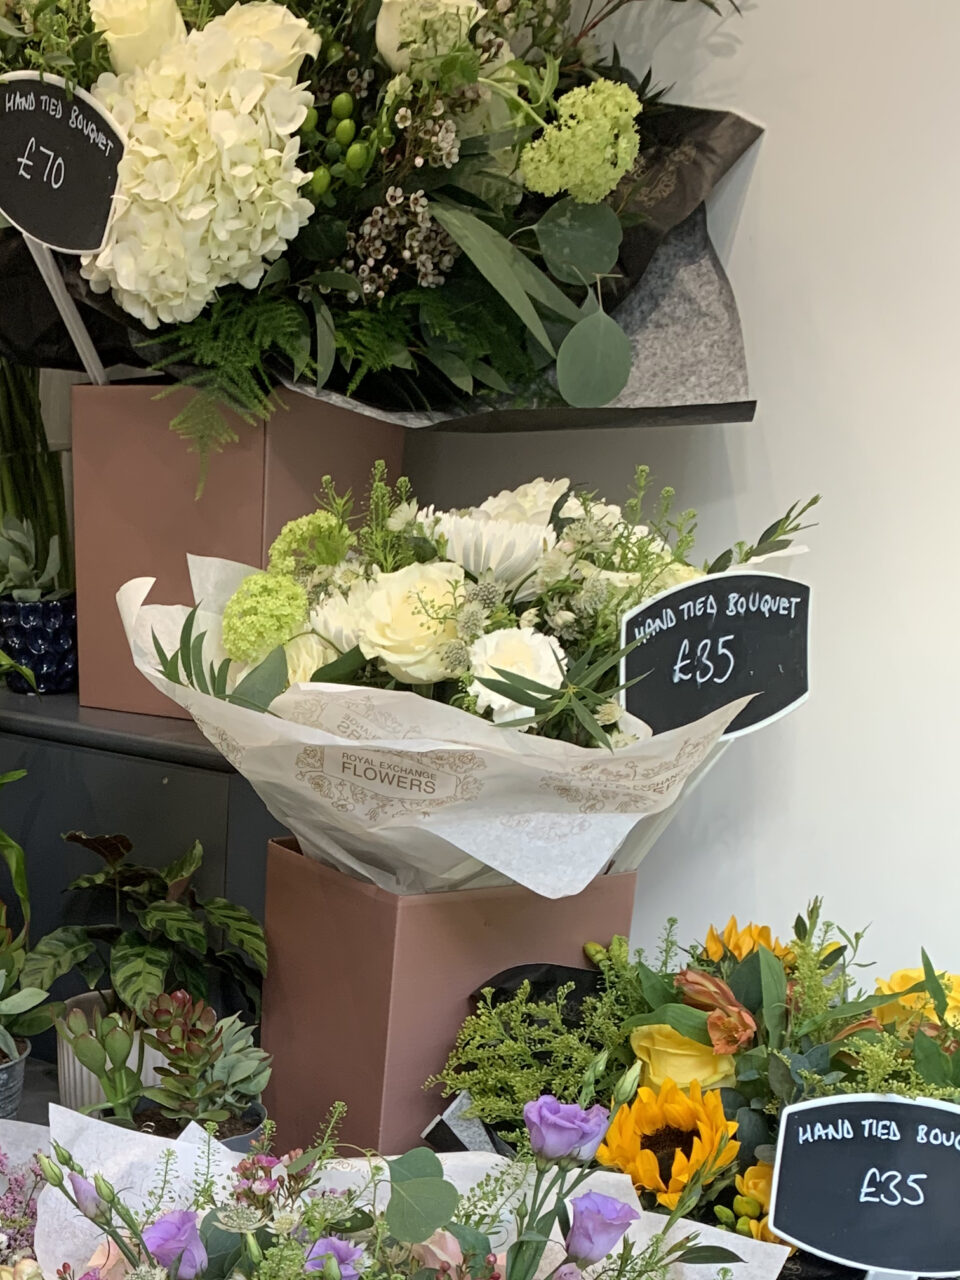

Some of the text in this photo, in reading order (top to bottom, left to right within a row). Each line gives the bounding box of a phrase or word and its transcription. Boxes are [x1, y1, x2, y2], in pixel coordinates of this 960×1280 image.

[5, 90, 36, 112] HAND
[40, 95, 63, 119] TIED
[17, 137, 65, 189] £70
[634, 608, 677, 646] HAND
[679, 594, 717, 622] TIED
[672, 634, 735, 684] £35
[341, 761, 436, 795] FLOWERS
[342, 752, 437, 781] ROYAL EXCHANGE
[798, 1118, 854, 1145] HAND
[861, 1118, 901, 1141] TIED
[859, 1167, 928, 1206] £35
